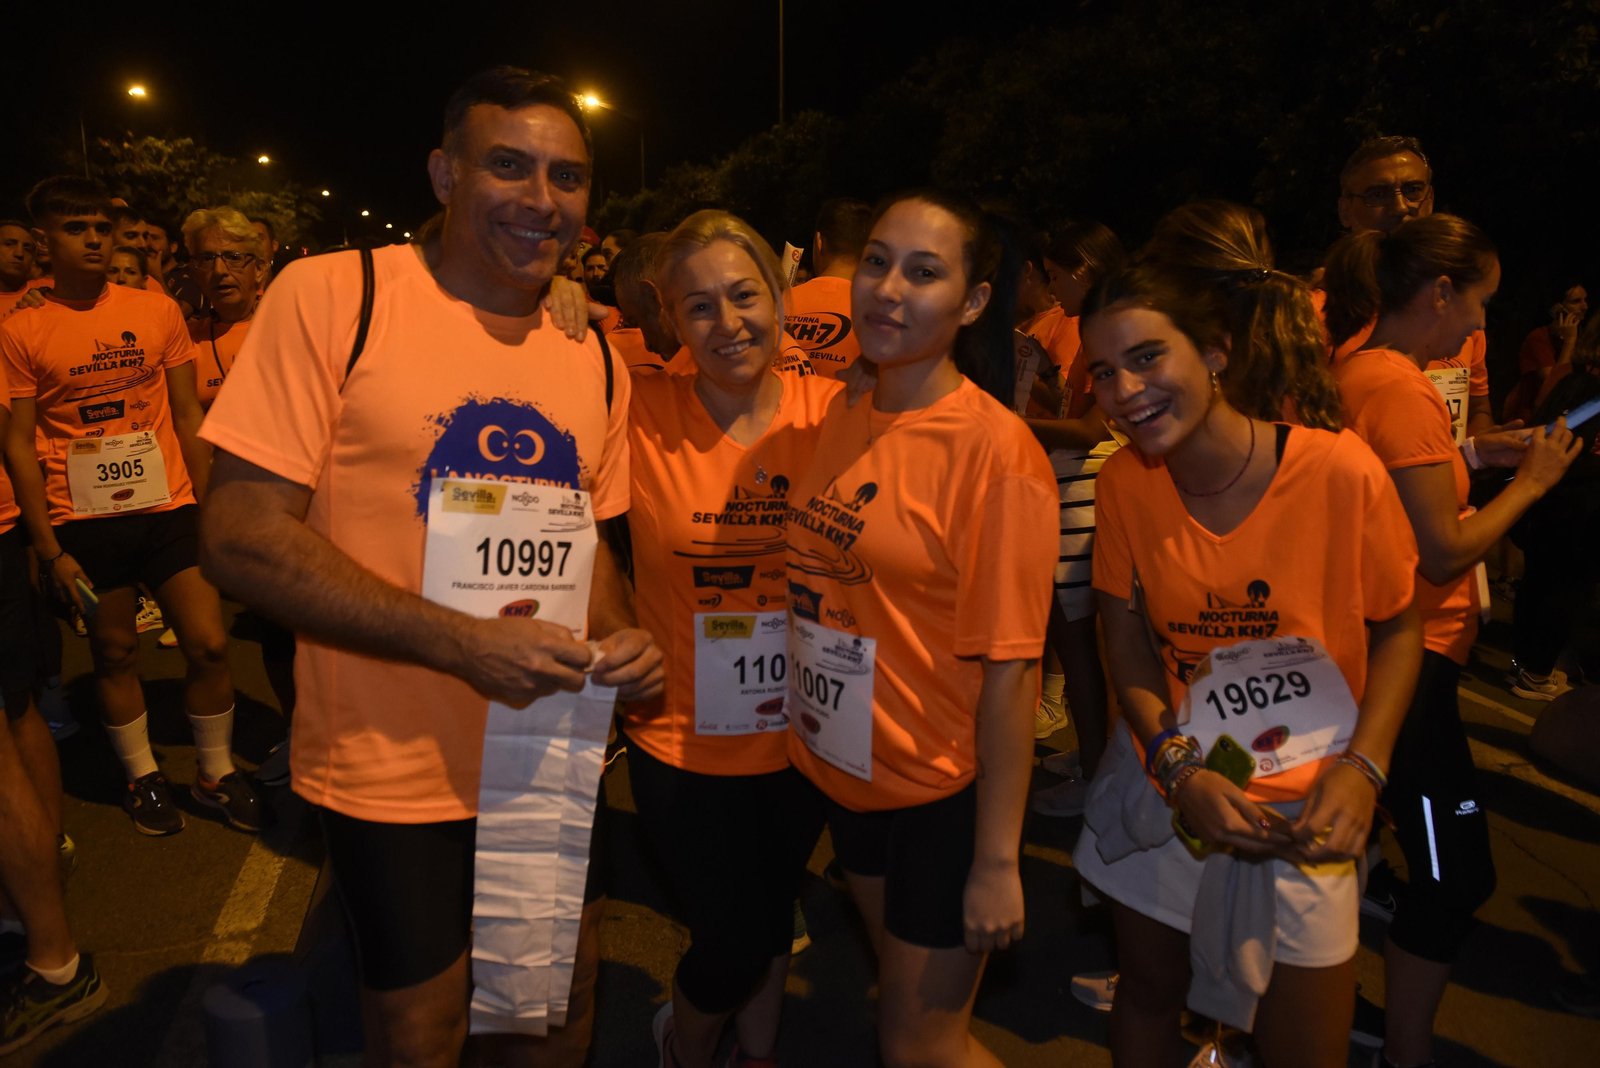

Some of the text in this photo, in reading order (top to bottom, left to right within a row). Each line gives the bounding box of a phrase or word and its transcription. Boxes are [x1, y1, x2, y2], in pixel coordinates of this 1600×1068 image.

[92, 349, 145, 362] NOCTURNA
[809, 352, 846, 363] SEVILLA
[69, 361, 118, 377] SEVILLA
[97, 459, 144, 481] 3905
[692, 513, 756, 526] SEVILLA
[806, 497, 865, 534] NOCTURNA
[476, 538, 572, 577] 10997
[452, 582, 495, 591] FRANCISCO
[496, 583, 519, 591] JAVIER
[1199, 611, 1280, 623] NOCTURNA
[1168, 622, 1235, 638] SEVILLA
[1206, 671, 1311, 720] 19629
